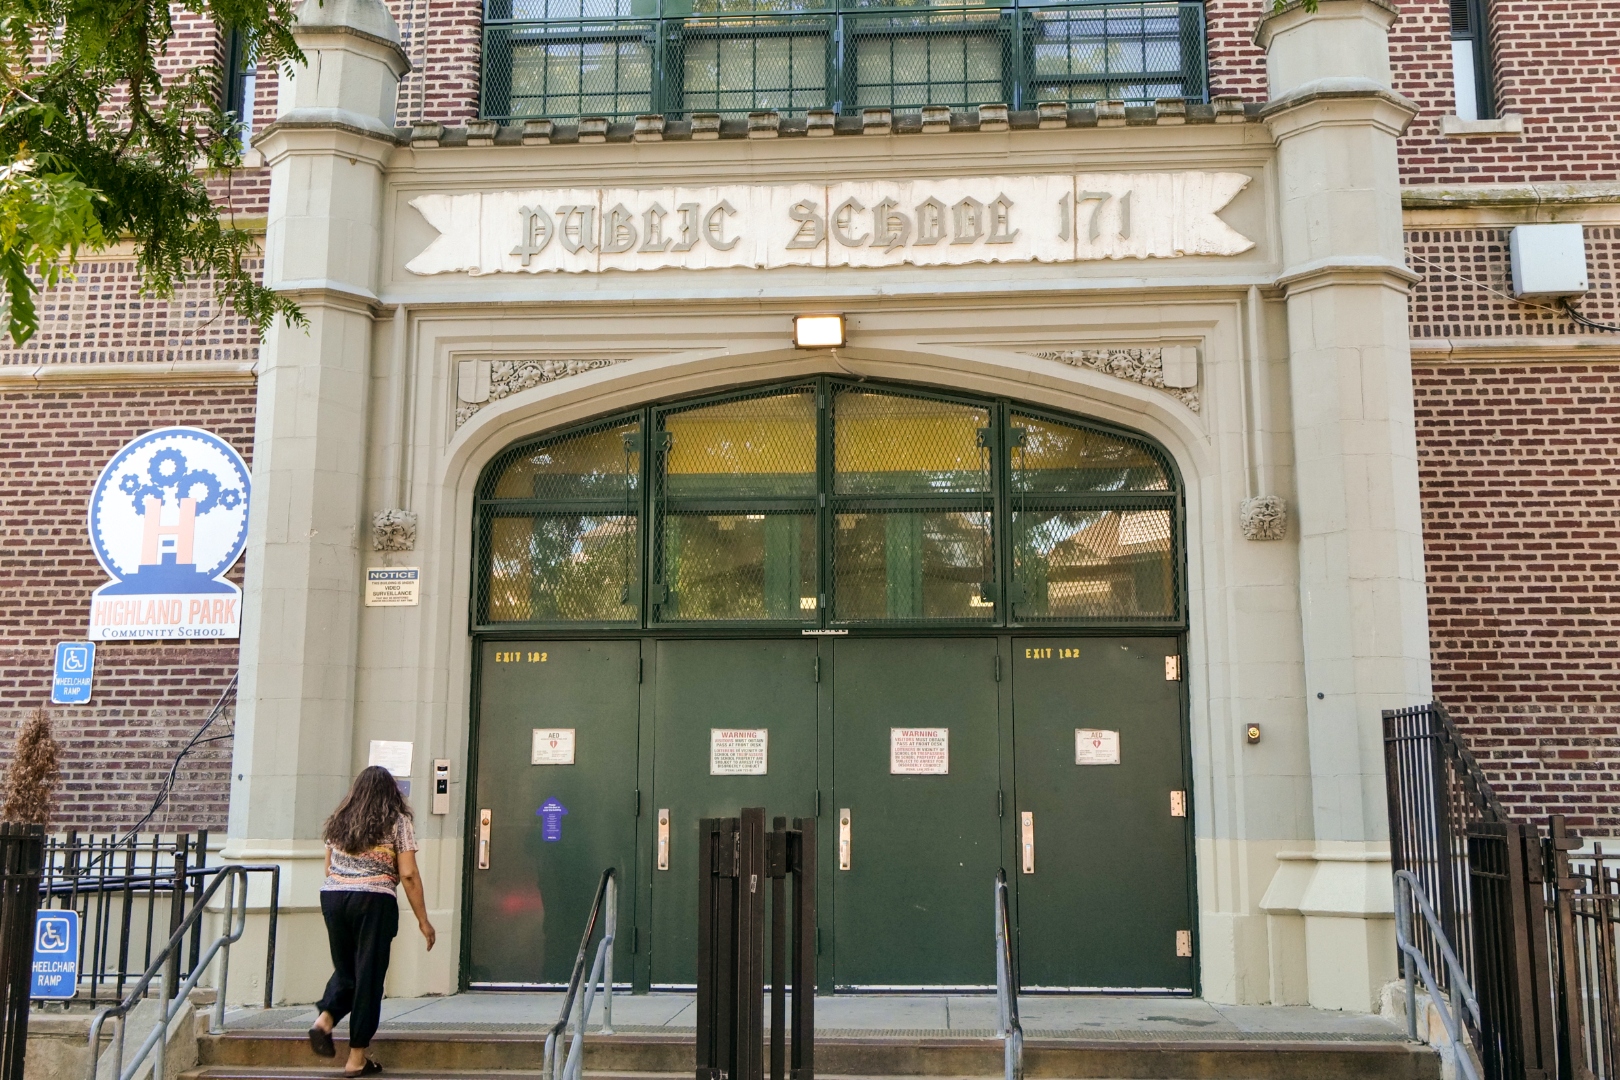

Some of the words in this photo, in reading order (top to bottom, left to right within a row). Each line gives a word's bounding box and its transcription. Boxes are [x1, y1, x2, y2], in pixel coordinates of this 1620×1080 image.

[510, 203, 740, 265] PUBLIC
[786, 192, 1019, 254] SCHOOL
[1058, 190, 1133, 243] 171
[94, 599, 182, 626] HIGHLAND
[188, 598, 237, 625] PARK
[495, 652, 521, 663] EXIT
[1025, 648, 1051, 659] EXIT
[55, 677, 91, 687] WHEELCHAIR
[63, 687, 81, 696] RAMP
[32, 961, 75, 972] HEELCHAIR
[37, 975, 62, 986] RAMP
